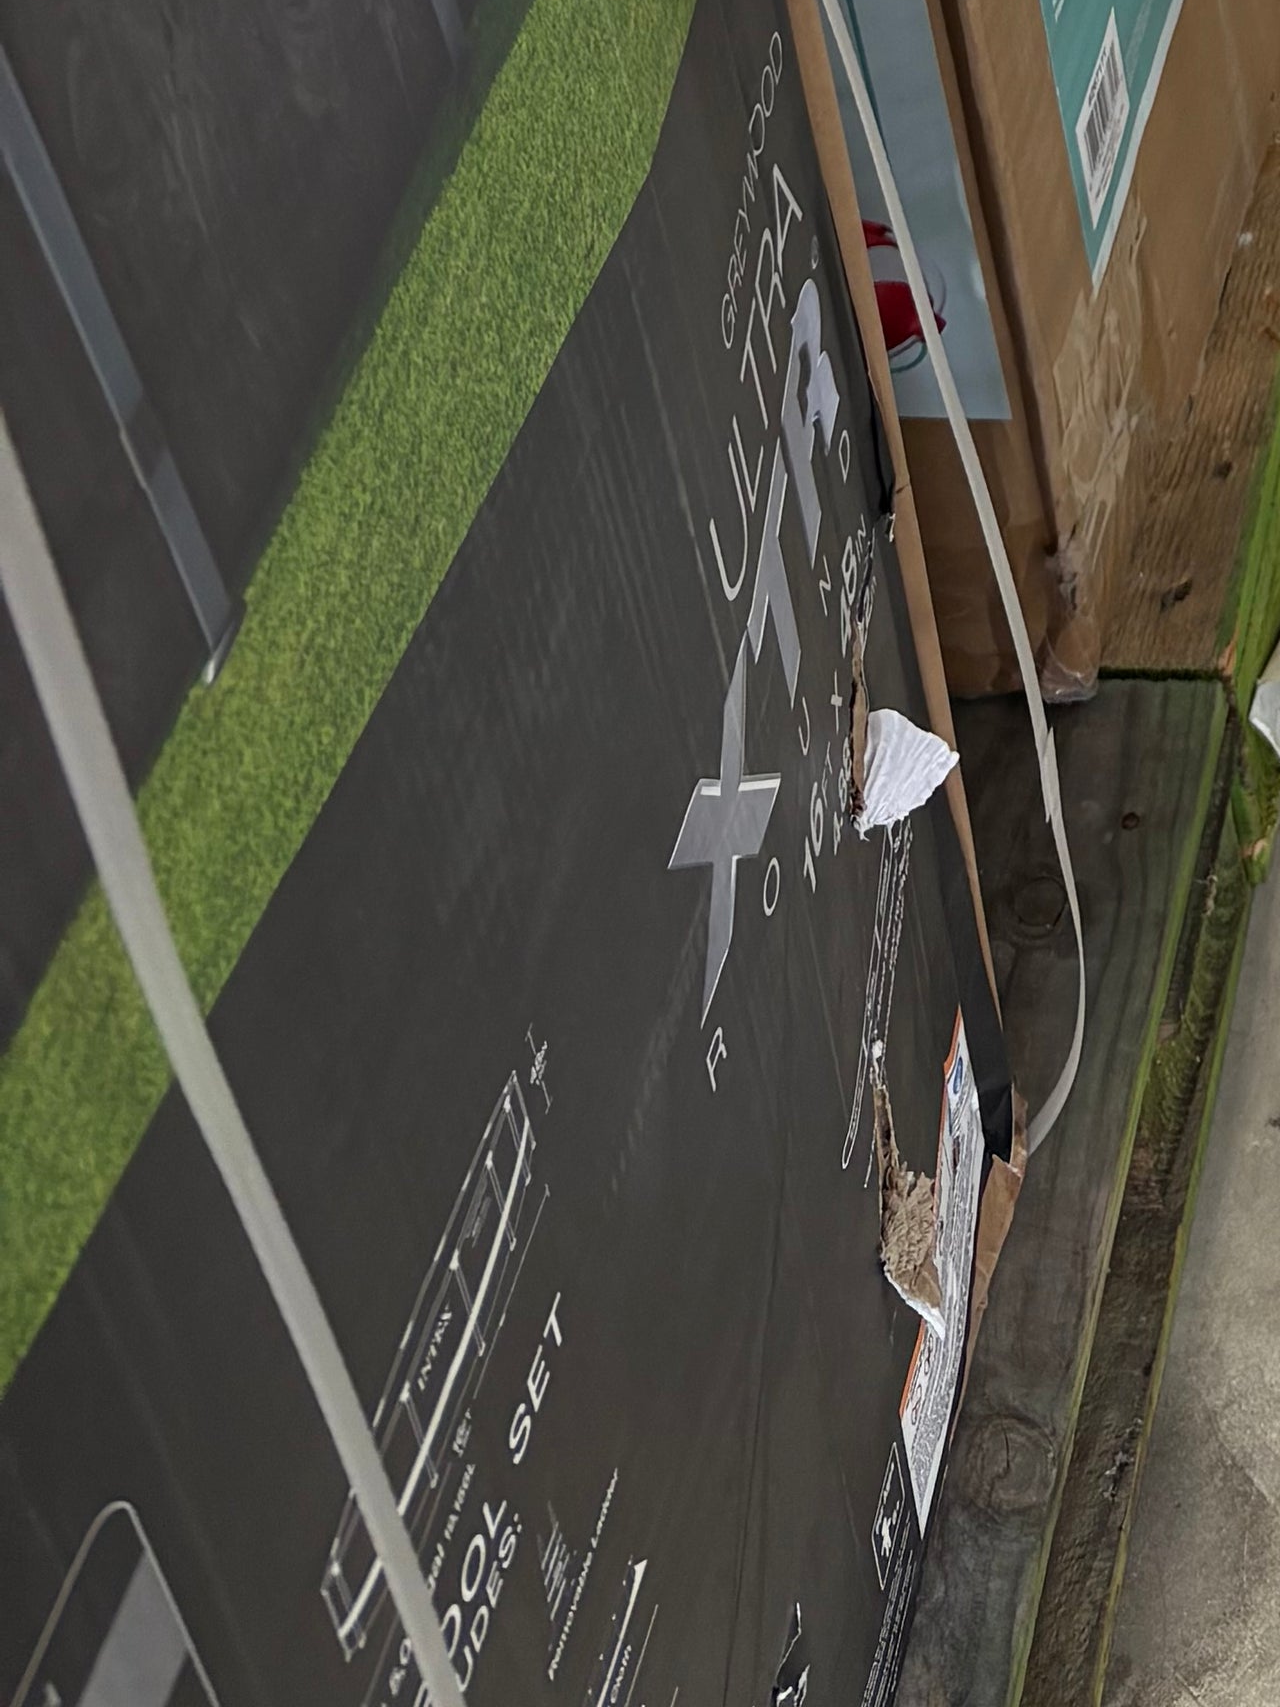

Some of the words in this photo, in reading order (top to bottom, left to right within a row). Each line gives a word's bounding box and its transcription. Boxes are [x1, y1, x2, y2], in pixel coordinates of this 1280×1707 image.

[721, 31, 785, 351] GREYWOOD
[708, 163, 804, 603] ULTRA
[508, 1290, 563, 1465] SET
